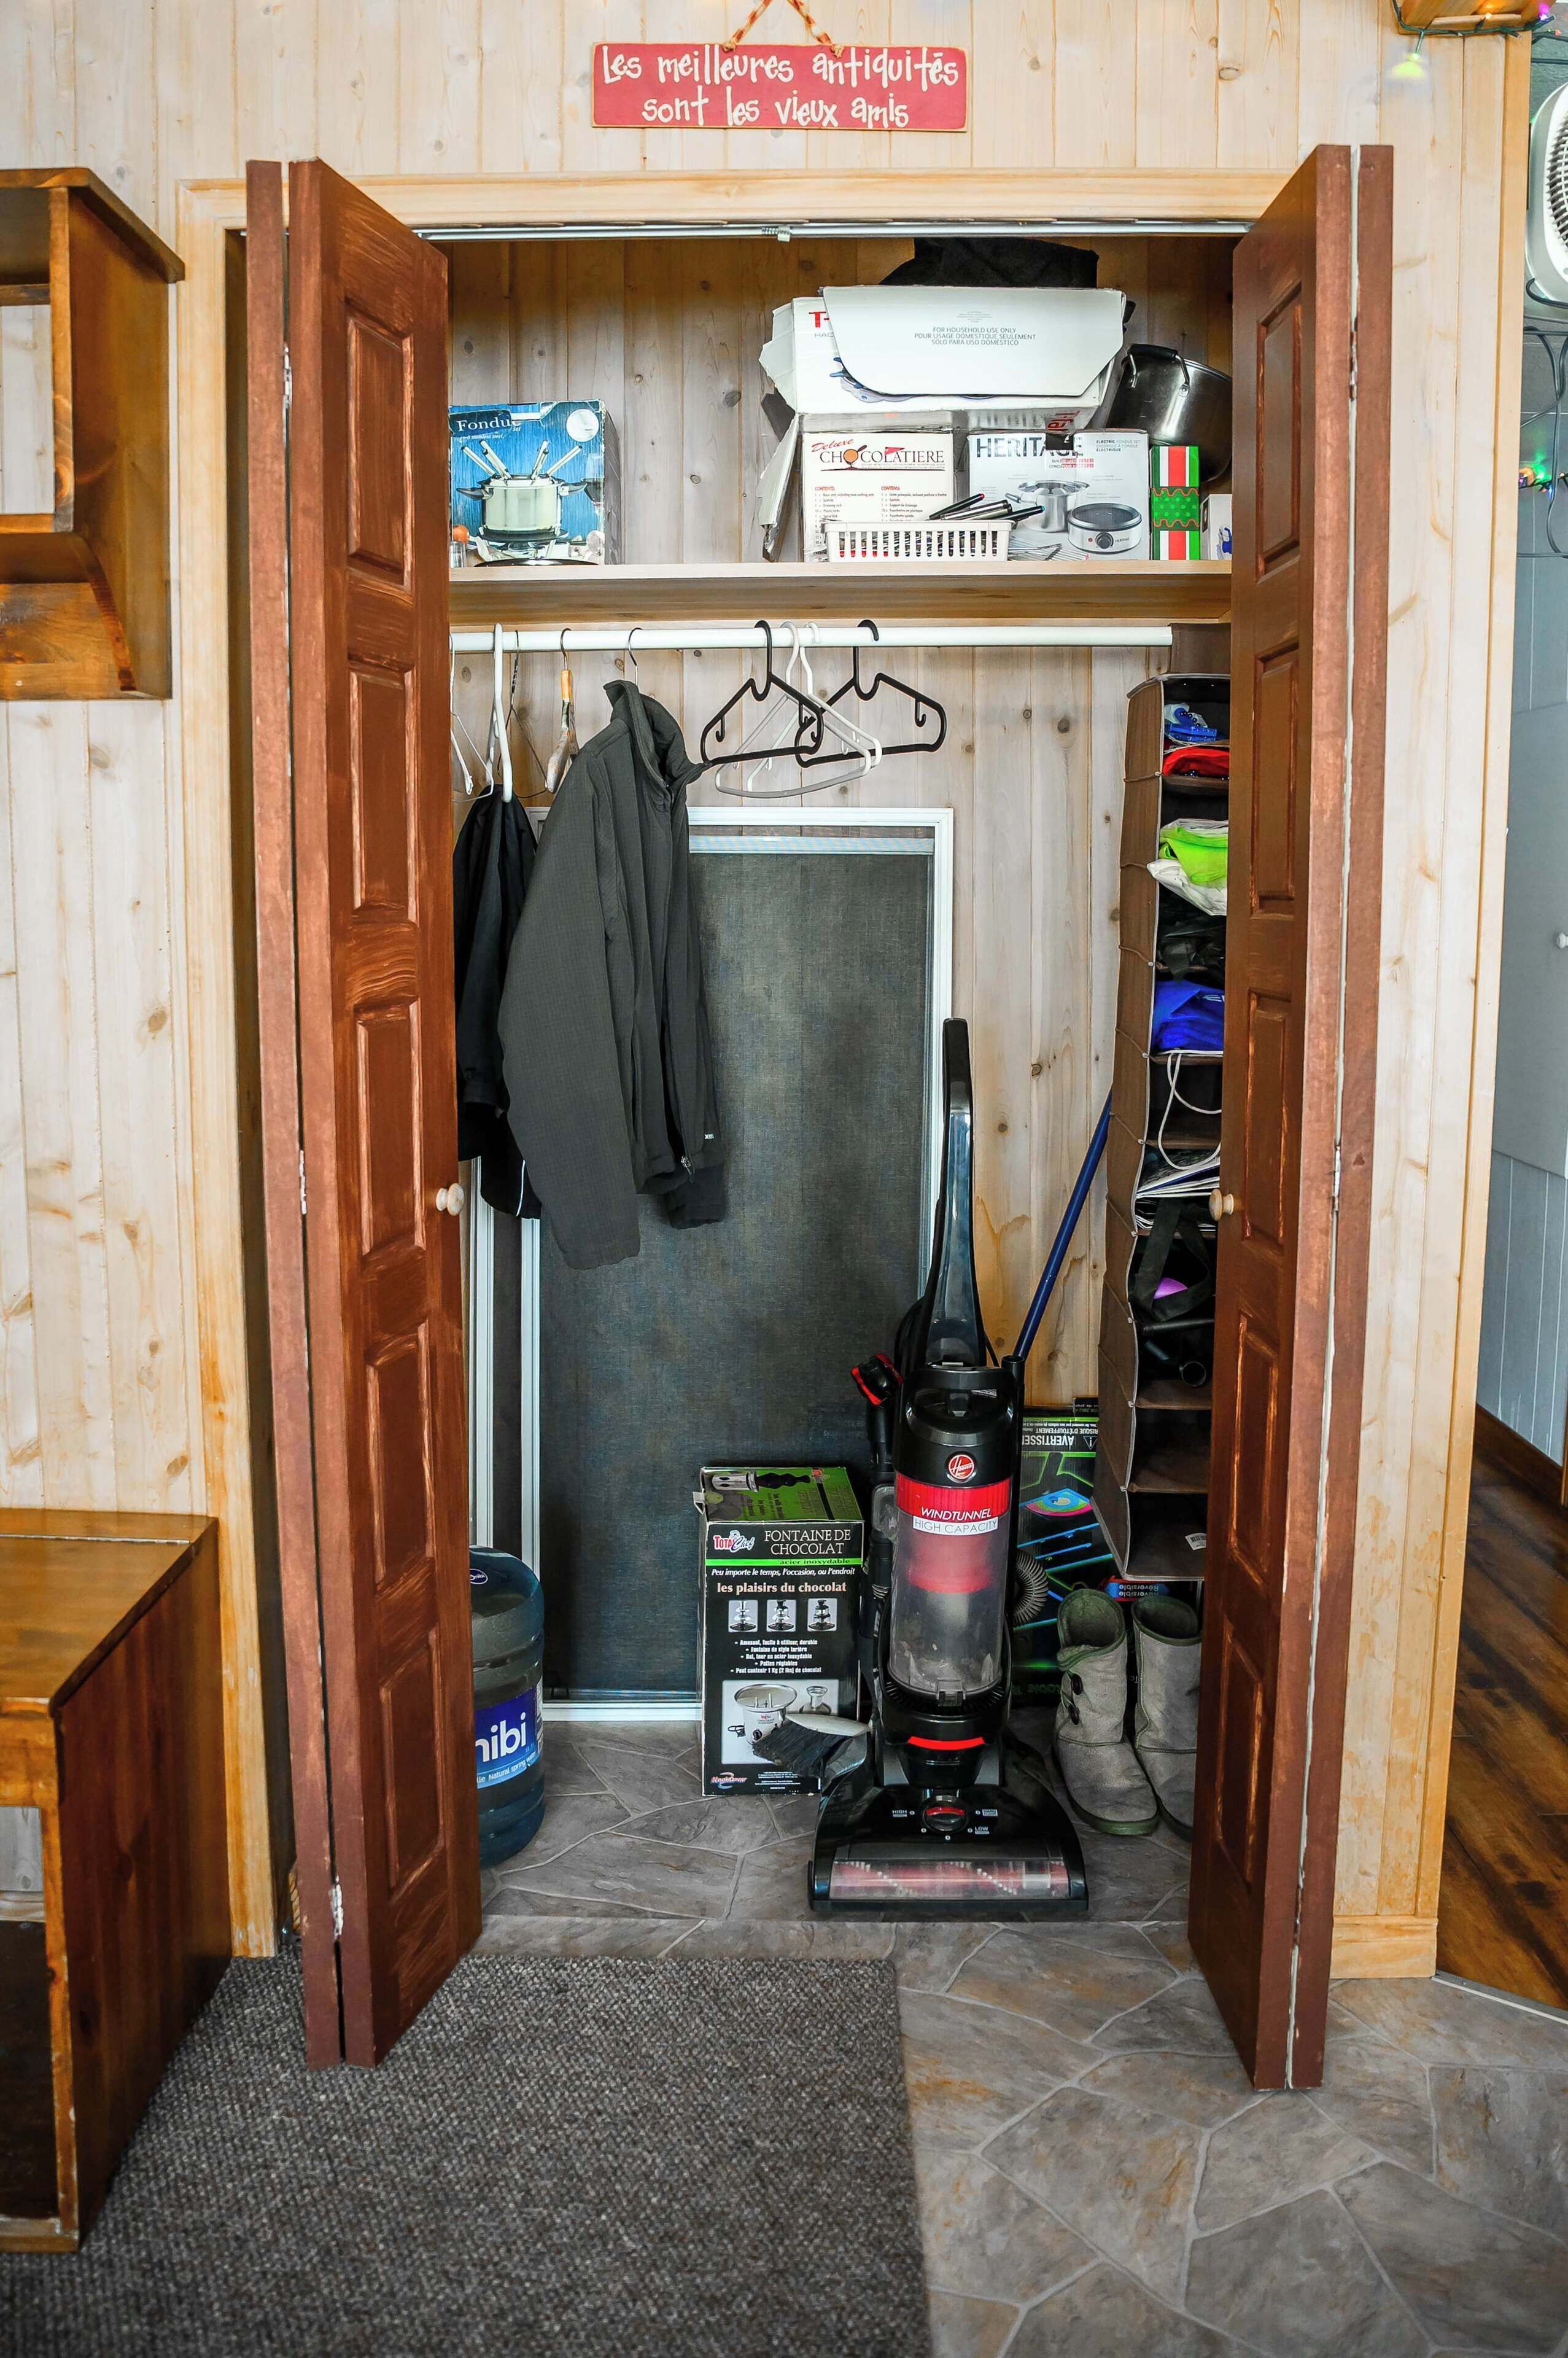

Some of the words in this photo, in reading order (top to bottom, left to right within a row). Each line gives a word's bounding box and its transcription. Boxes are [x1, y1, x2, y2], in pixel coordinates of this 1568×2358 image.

[602, 45, 642, 85] Les
[658, 44, 794, 85] meilleures
[812, 47, 959, 91] antiquités
[642, 85, 709, 126] sont
[726, 86, 760, 127] les
[775, 90, 839, 128] vieux
[851, 93, 909, 128] amis
[811, 439, 855, 453] Deluxe
[820, 449, 944, 465] CHOCOLATIERE
[922, 1506, 992, 1521] WINDTUNNEL
[915, 1518, 941, 1532] HIGH
[944, 1520, 997, 1533] CAPACITY
[764, 1530, 832, 1542] FONTAINE
[834, 1529, 852, 1541] DE
[731, 1535, 756, 1553] Chef
[770, 1543, 845, 1555] CHOCOLAT
[717, 1582, 733, 1593] les
[735, 1582, 777, 1595] plaisirs
[780, 1582, 796, 1592] du
[798, 1581, 847, 1592] chocolat
[488, 1767, 510, 1781] Natural
